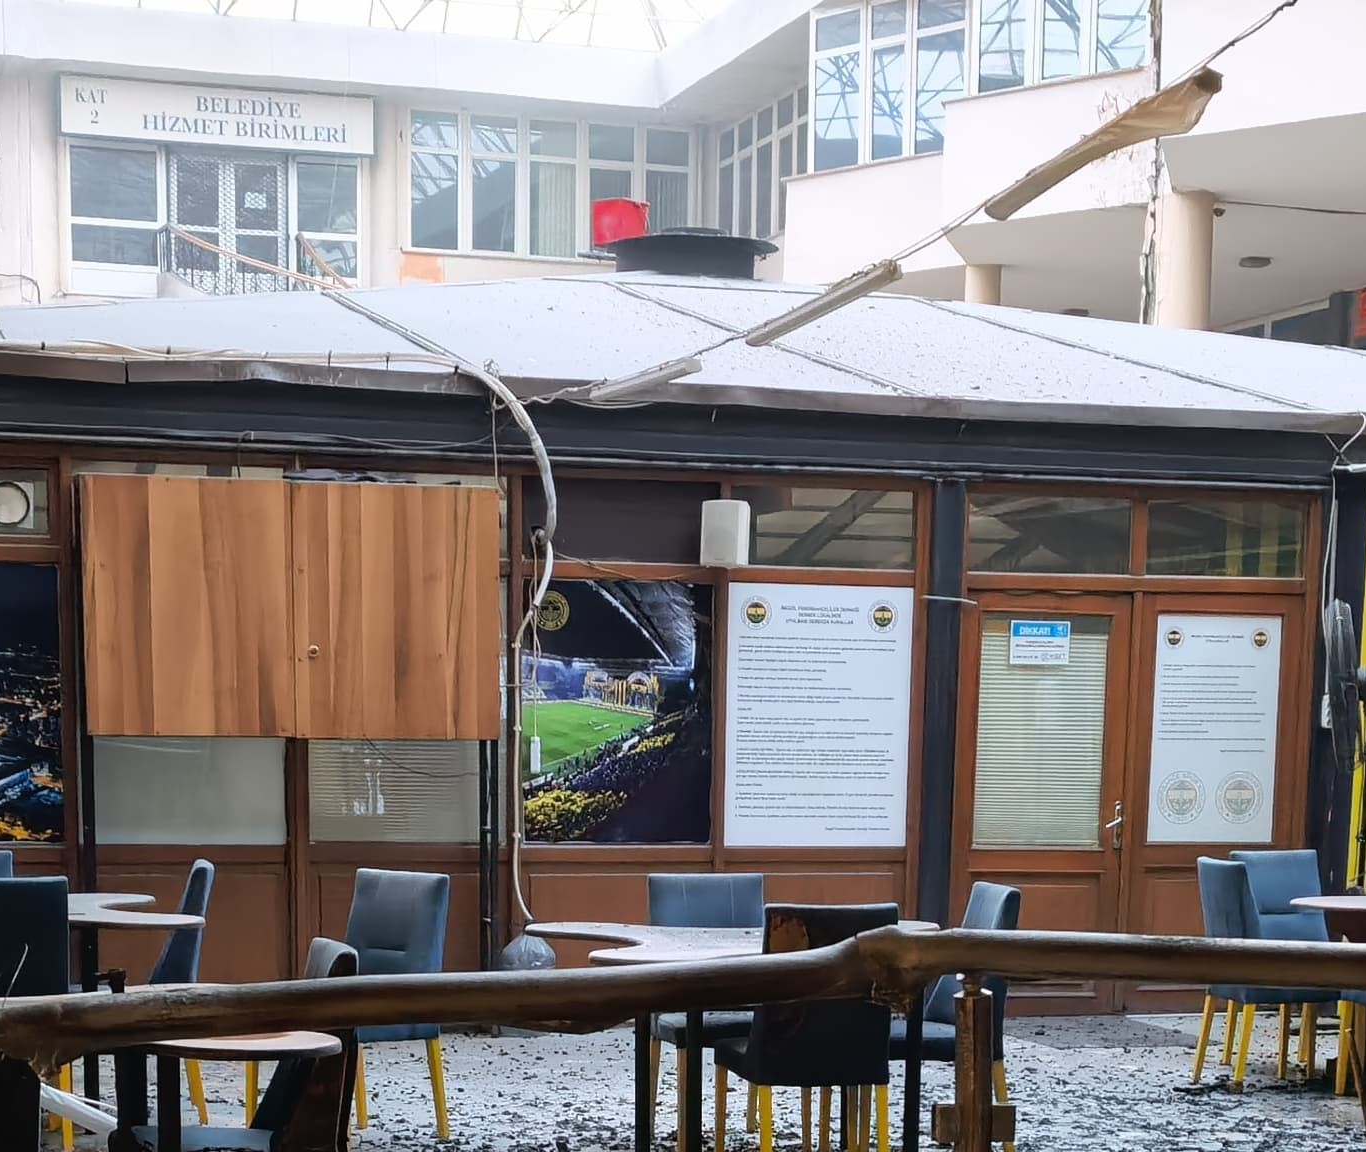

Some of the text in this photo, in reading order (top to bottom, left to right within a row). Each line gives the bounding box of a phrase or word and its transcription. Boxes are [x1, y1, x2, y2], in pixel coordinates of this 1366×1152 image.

[74, 87, 107, 104] KAT
[195, 94, 302, 119] BELEDİYE
[90, 110, 99, 125] 2
[142, 111, 348, 144] HİZMET BİRİMLERİ
